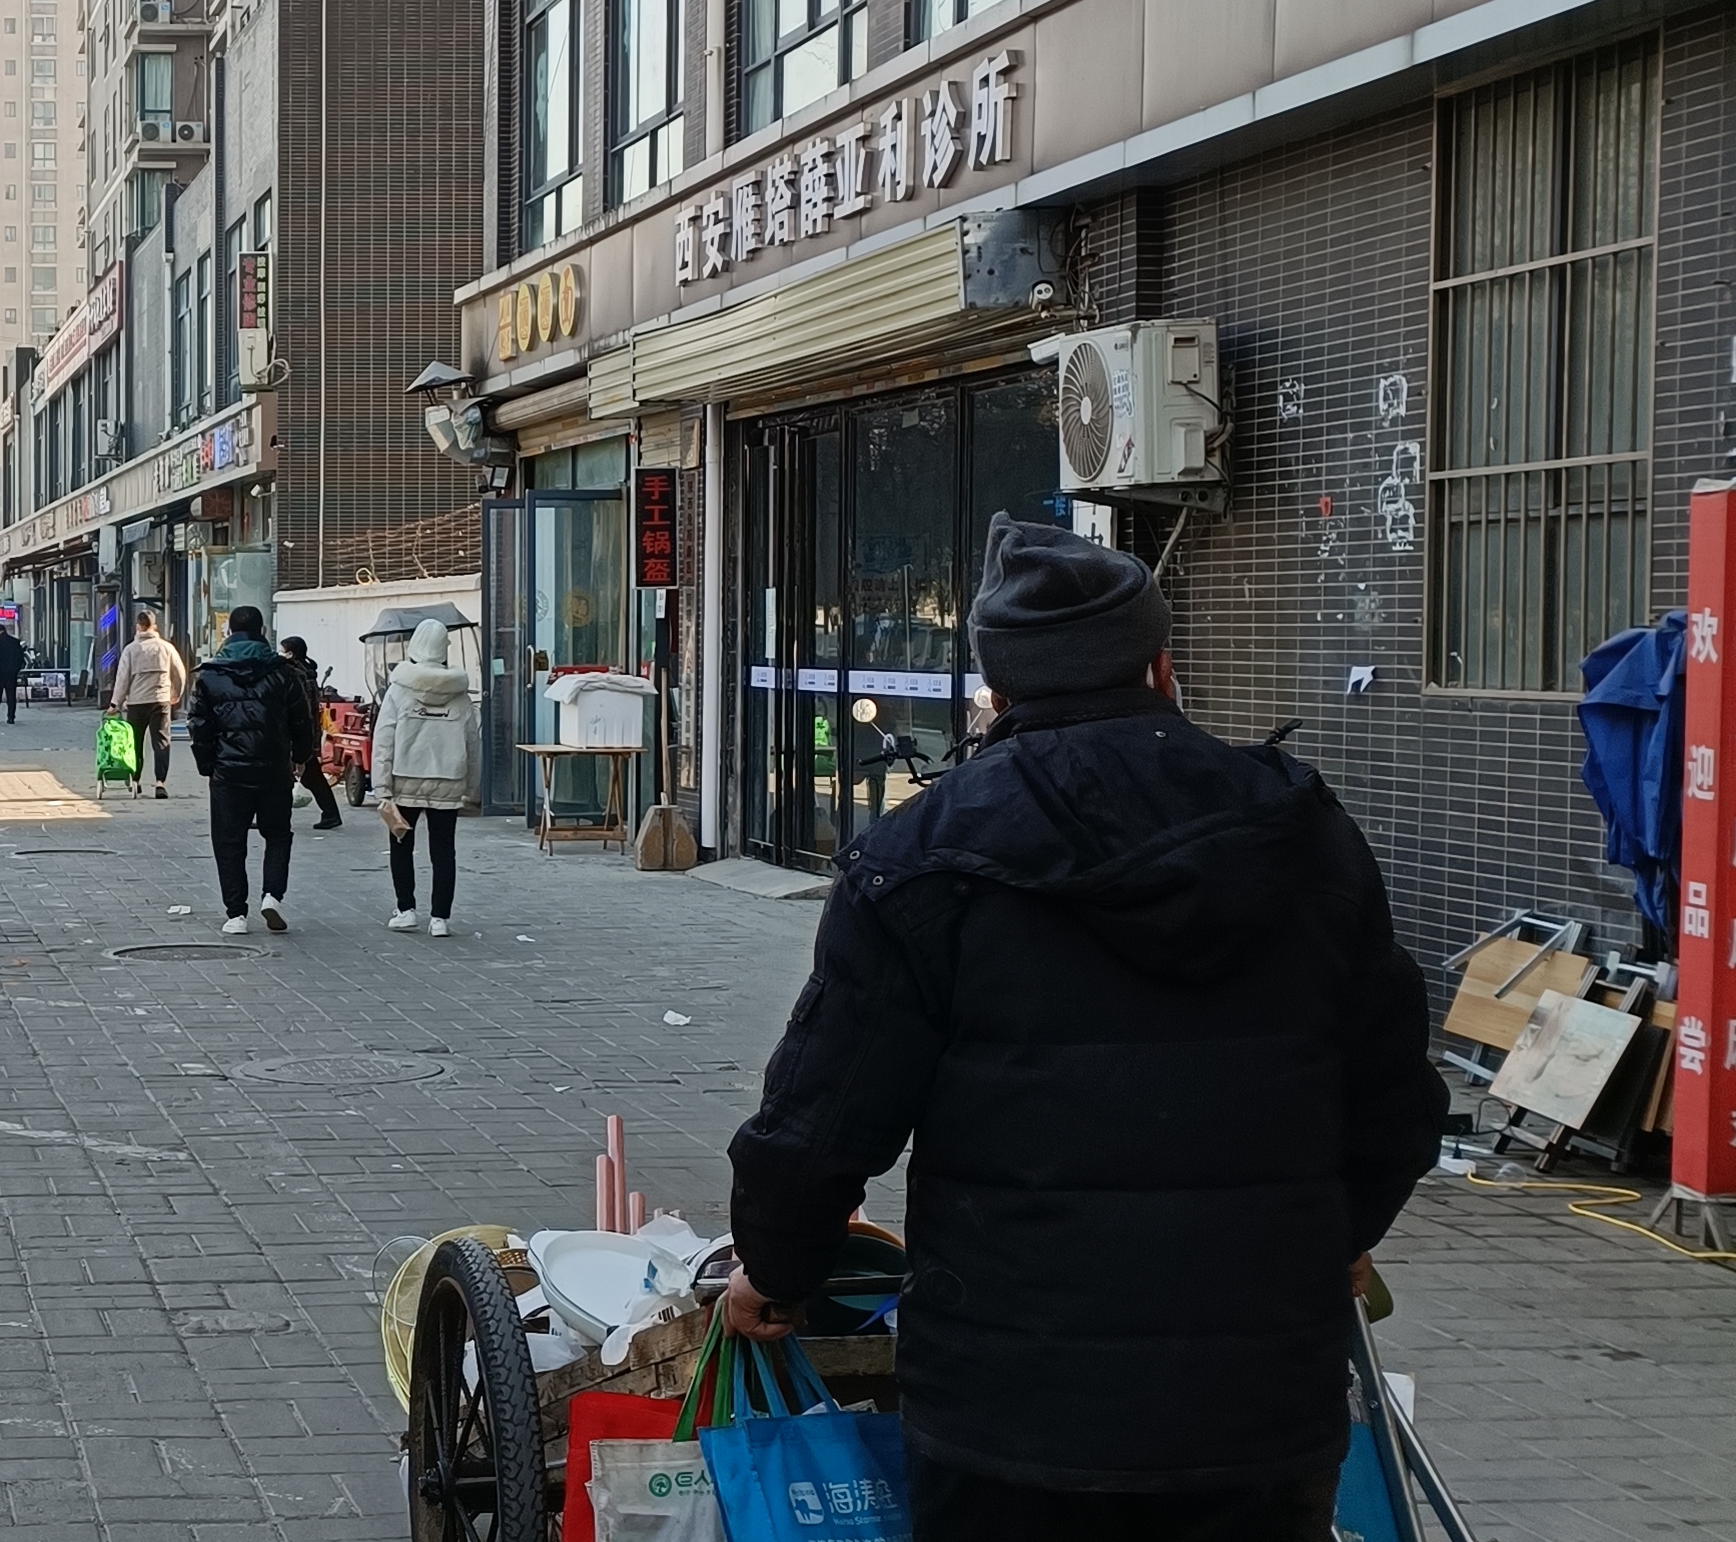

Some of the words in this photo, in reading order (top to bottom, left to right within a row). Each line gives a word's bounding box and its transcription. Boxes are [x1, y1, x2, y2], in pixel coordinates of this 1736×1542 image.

[674, 48, 1019, 287] 西安雁塔薛亚利诊所
[642, 475, 672, 582] 手工锅盔
[1677, 607, 1719, 1076] 欢迎品尝
